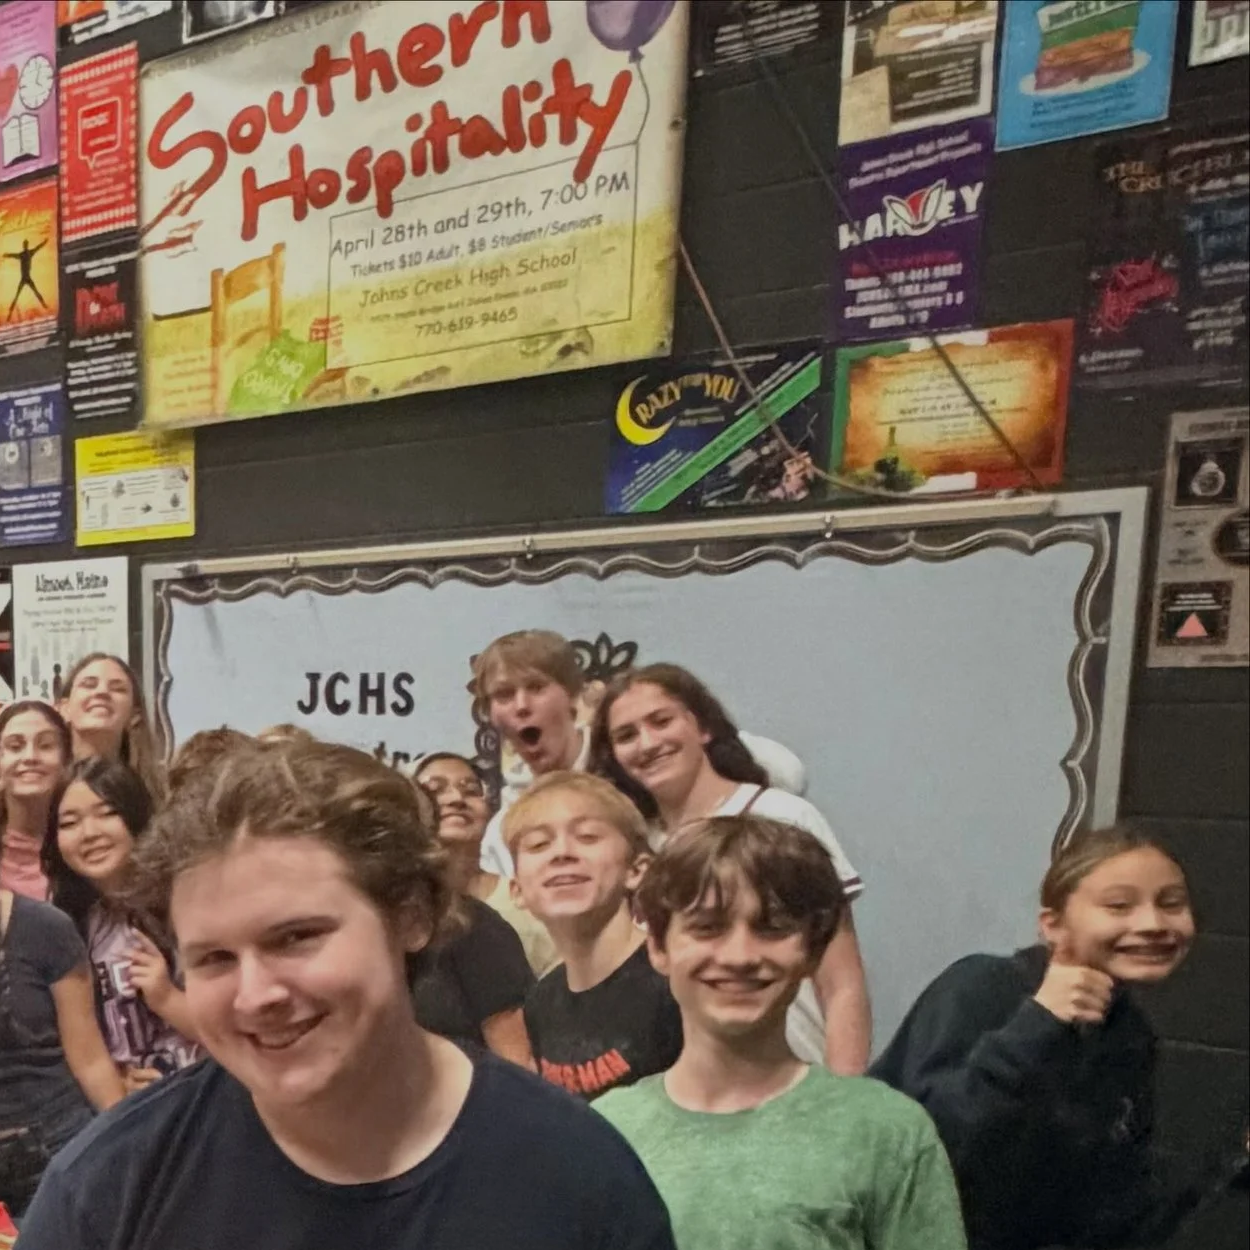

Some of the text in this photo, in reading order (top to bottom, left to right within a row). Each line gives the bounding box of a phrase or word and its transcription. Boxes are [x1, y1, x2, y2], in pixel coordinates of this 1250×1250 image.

[147, 0, 552, 214] Southern
[241, 58, 633, 241] Hospitality
[330, 171, 630, 265] April 28th and 29th, 7:00 PM
[350, 259, 396, 279] Tickets
[358, 283, 409, 308] Johns
[413, 274, 464, 298] Creek
[470, 264, 511, 287] High
[517, 246, 579, 277] School
[296, 671, 417, 717] JCHS
